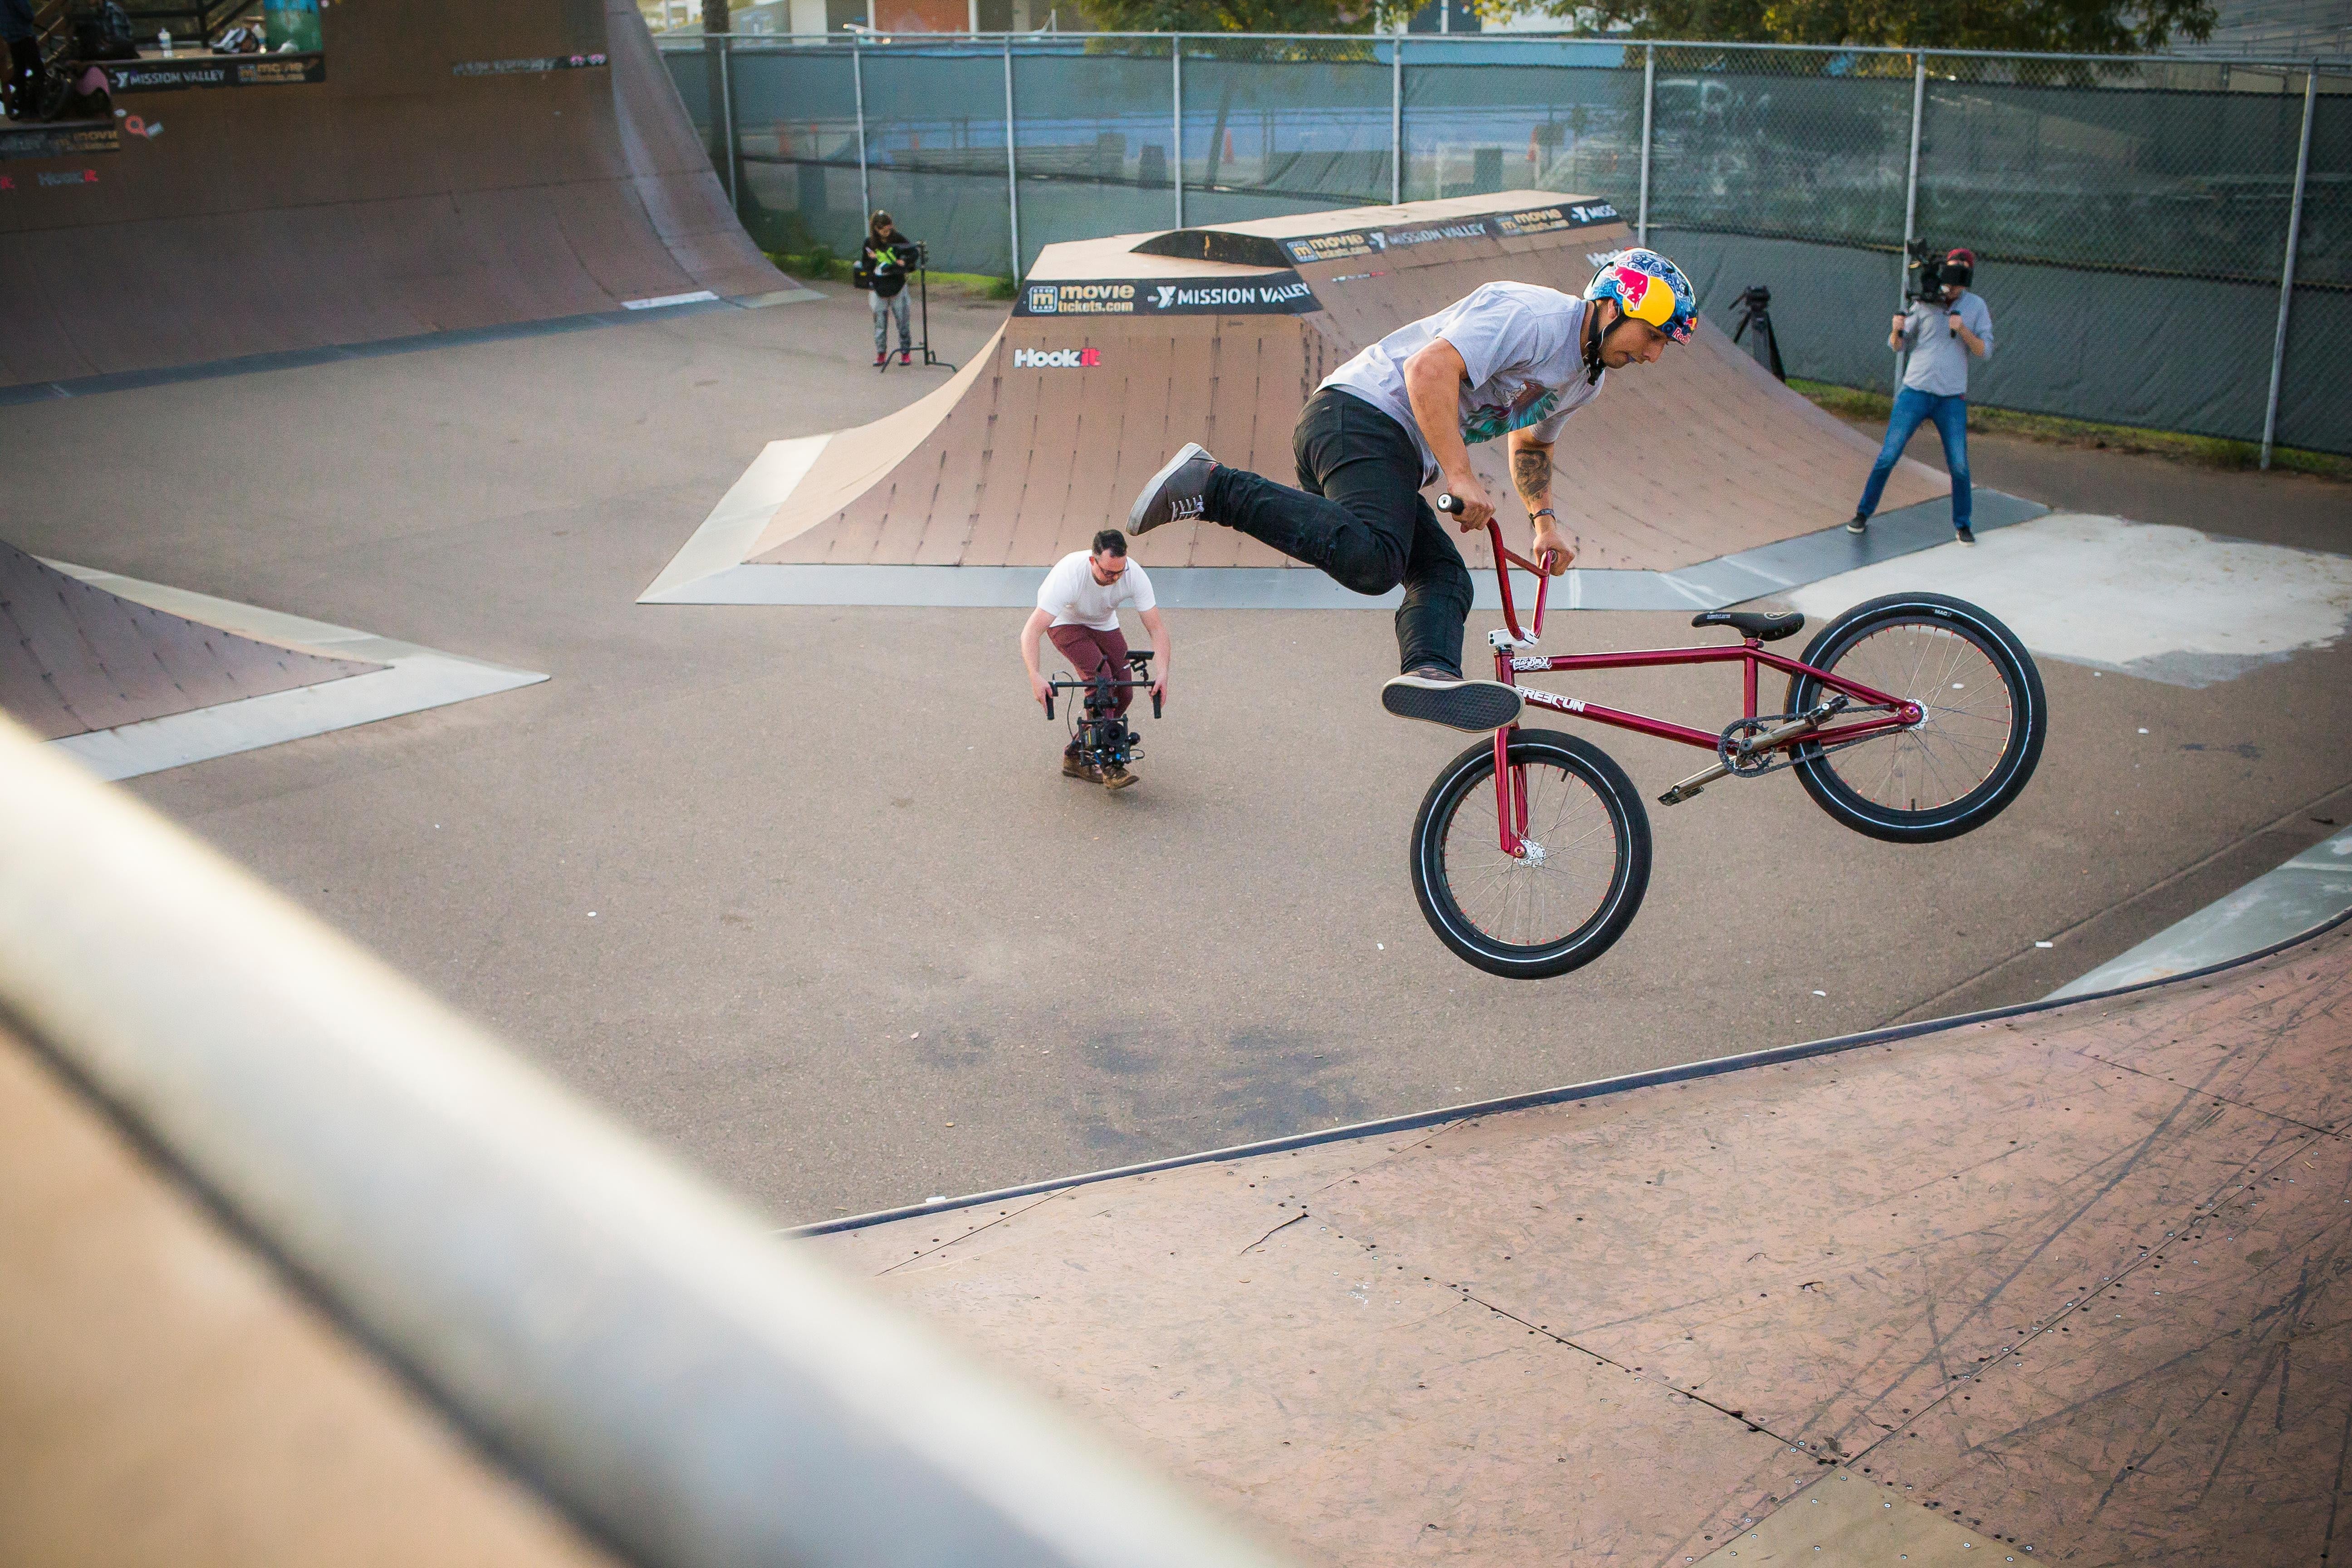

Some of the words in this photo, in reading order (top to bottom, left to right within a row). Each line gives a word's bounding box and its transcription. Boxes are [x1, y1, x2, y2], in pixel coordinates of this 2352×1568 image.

[130, 72, 181, 84] MISSION
[183, 69, 225, 83] VALLEY
[1060, 285, 1135, 299] movie
[1177, 288, 1255, 304] MISSION
[1259, 283, 1310, 303] VALLEY
[1058, 299, 1133, 312] tickets.com
[1014, 348, 1101, 368] Hookit
